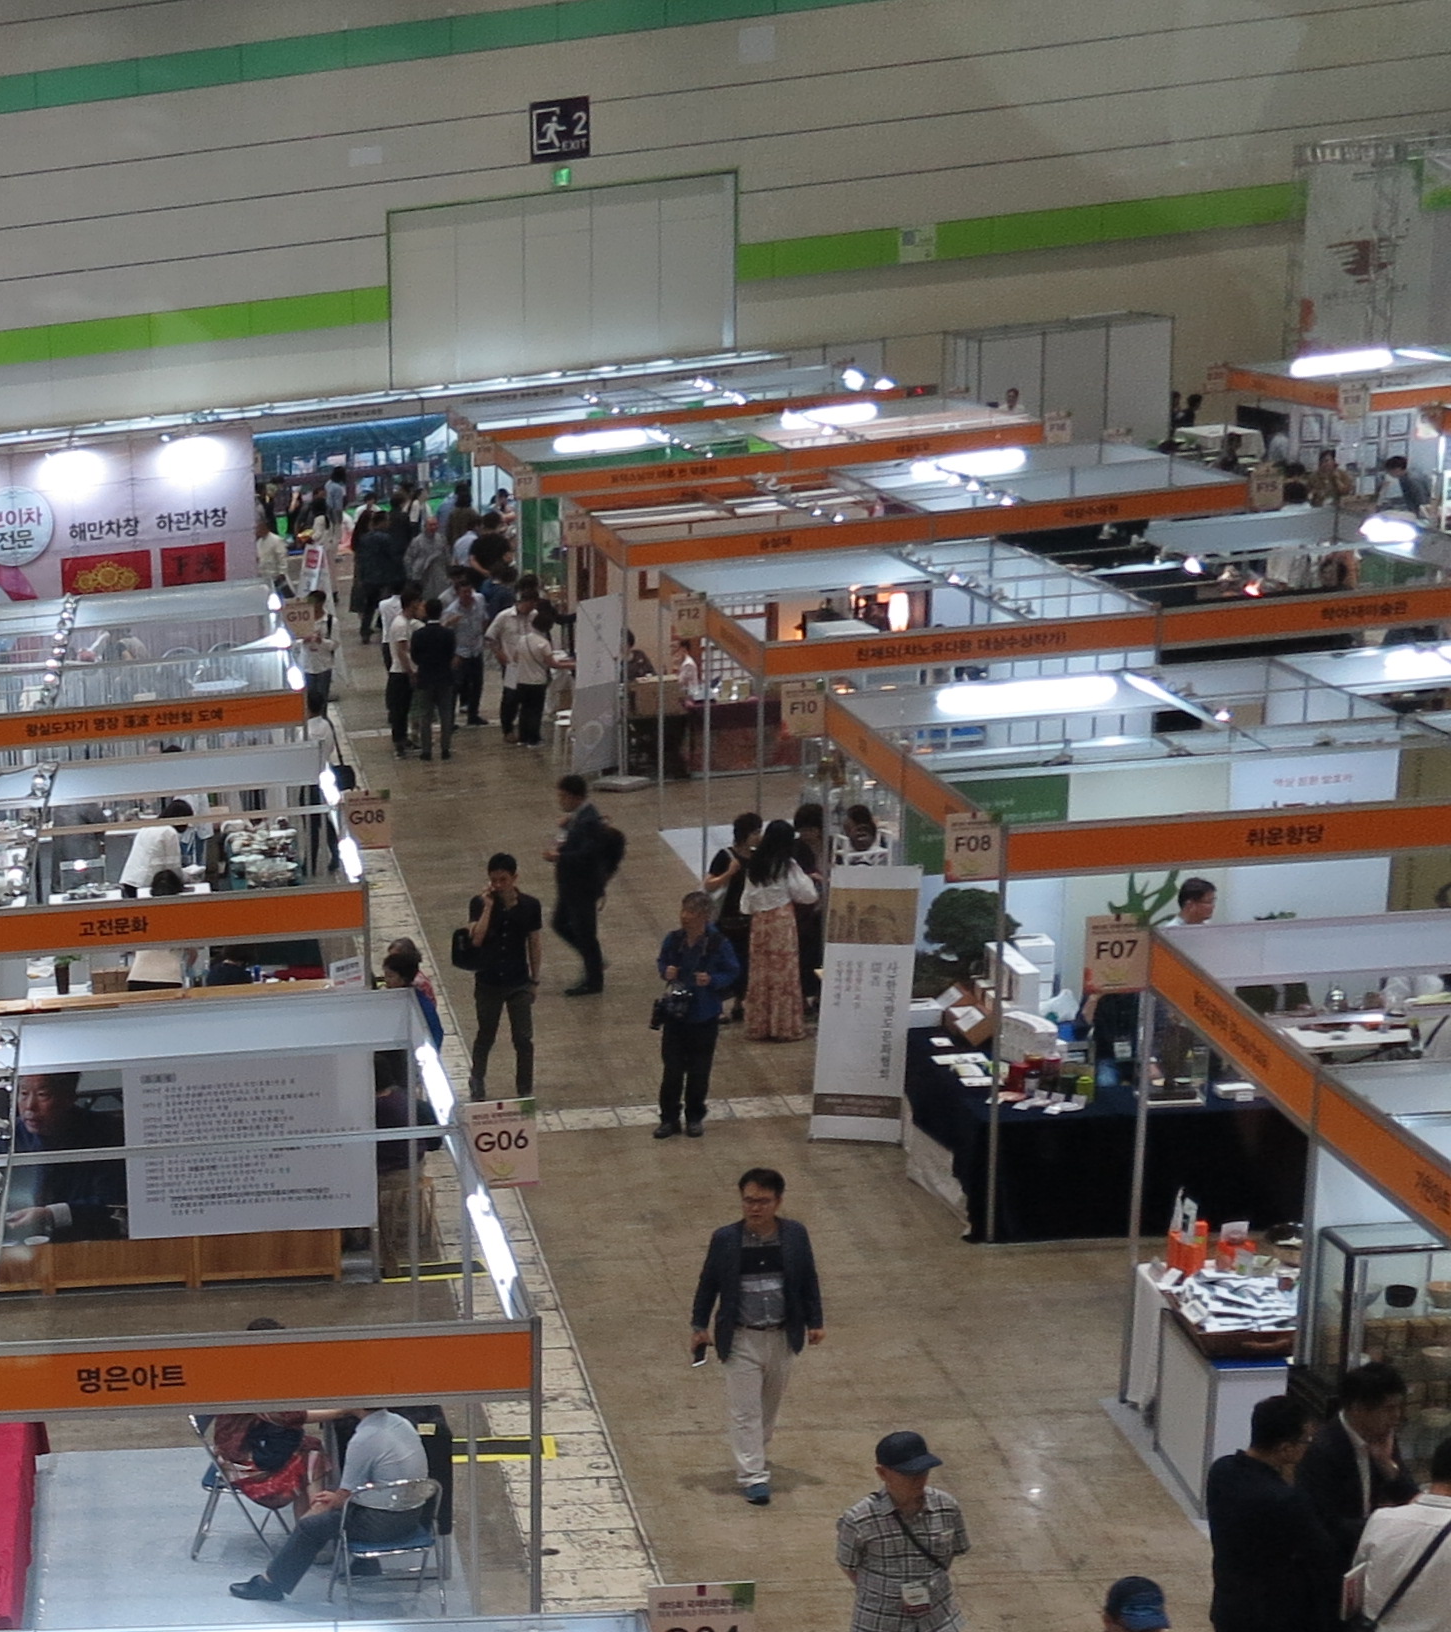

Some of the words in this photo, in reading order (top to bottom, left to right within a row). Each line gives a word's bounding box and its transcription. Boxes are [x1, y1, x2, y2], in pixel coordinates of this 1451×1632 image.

[571, 111, 588, 135] 2
[561, 137, 587, 150] EXIT
[68, 516, 140, 542] 해만차창
[155, 507, 228, 534] 하관차창
[286, 609, 311, 623] G10
[677, 607, 701, 622] F12
[789, 700, 818, 716] F10
[25, 718, 89, 737] 왕실도자기
[197, 706, 224, 722] 도예
[348, 807, 386, 826] G08
[953, 834, 992, 853] F08
[1244, 824, 1325, 847] 취운향당
[78, 913, 149, 939] 고전문화
[1094, 940, 1138, 959] F07
[474, 1128, 529, 1153] G06
[76, 1362, 188, 1394] 명은아트
